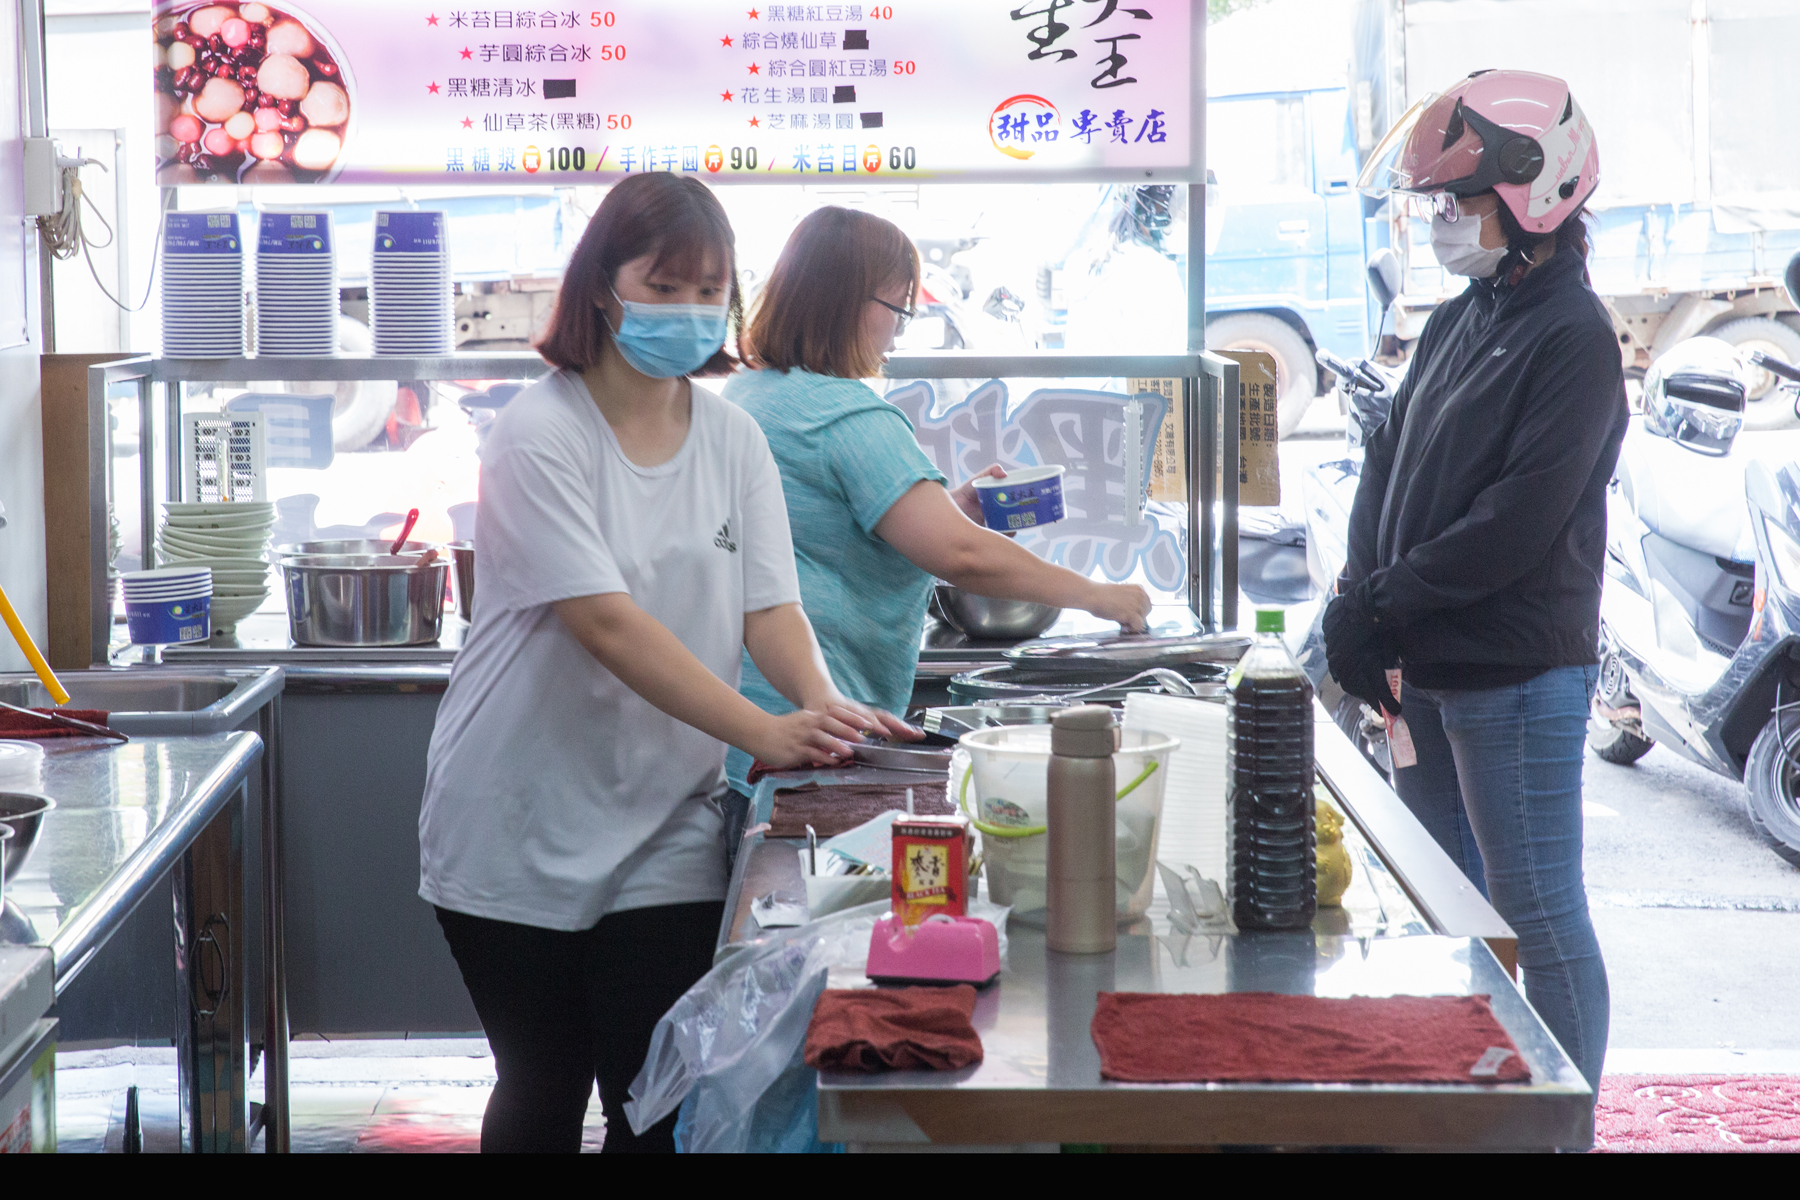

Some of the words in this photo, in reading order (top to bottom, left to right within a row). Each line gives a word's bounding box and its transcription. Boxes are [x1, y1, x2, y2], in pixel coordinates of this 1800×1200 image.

[449, 10, 581, 28] 米苔目綜合冰
[590, 11, 616, 27] 50
[767, 5, 863, 22] 黑糖紅豆湯
[870, 6, 893, 20] 40
[742, 31, 837, 50] 綜合燒仙草
[479, 43, 592, 62] 芋圓綜合冰
[601, 45, 627, 61] 50
[768, 59, 888, 77] 綜合圓紅豆湯
[893, 60, 916, 75] 50
[448, 77, 536, 97] 黑糖清冰
[740, 86, 828, 104] 花生湯圓
[483, 112, 601, 131] 仙草茶(黑糖)
[606, 114, 632, 130] 50
[767, 113, 854, 130] 芝麻湯圓
[997, 112, 1059, 143] 甜品
[1070, 109, 1167, 144] 專賣店
[547, 147, 586, 171] 100
[620, 145, 699, 172] 手作芋圓
[730, 146, 758, 170] 90
[792, 143, 857, 172] 米苔目
[889, 146, 916, 170] 60
[1249, 382, 1260, 447] 生產批號:
[1263, 382, 1275, 447] 製造日期:
[932, 886, 946, 894] TEA
